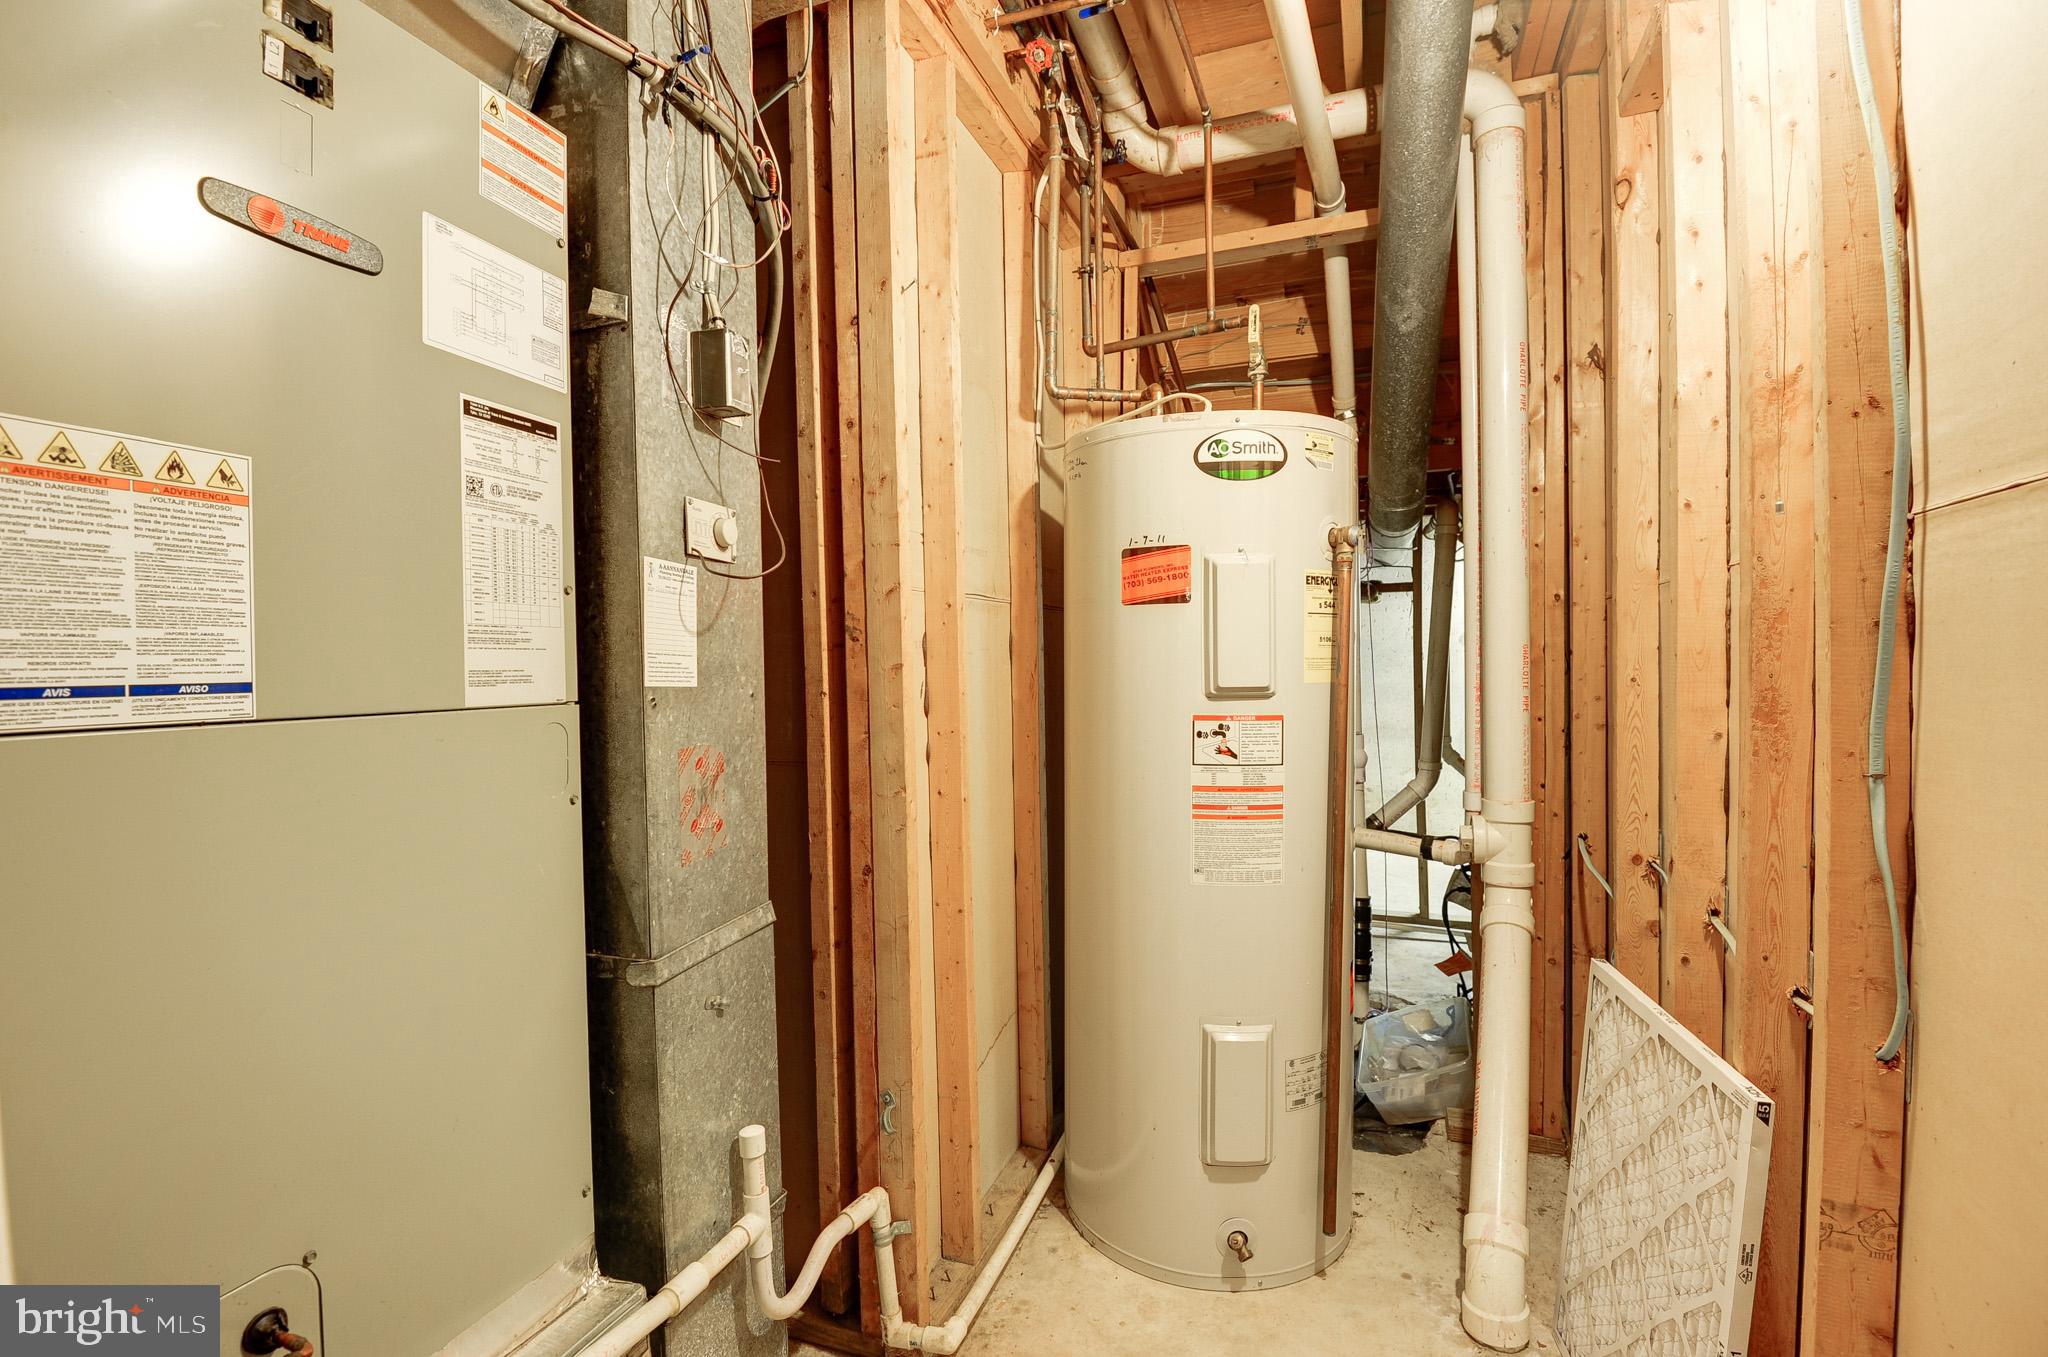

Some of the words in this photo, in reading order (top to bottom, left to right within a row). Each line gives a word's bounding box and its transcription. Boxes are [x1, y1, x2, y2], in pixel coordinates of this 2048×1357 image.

[292, 218, 351, 254] TRANE
[11, 465, 110, 486] AVERTISSEMENT
[44, 480, 109, 496] DANGEREUSE!
[163, 486, 231, 503] ADVERTENCIA
[187, 500, 233, 512] PELIGROSO!
[1140, 569, 1162, 578] HEATER
[1163, 564, 1189, 573] EXPRESS
[1123, 580, 1144, 591] (703)
[42, 688, 72, 698] AVIS
[178, 684, 209, 694] AVISO
